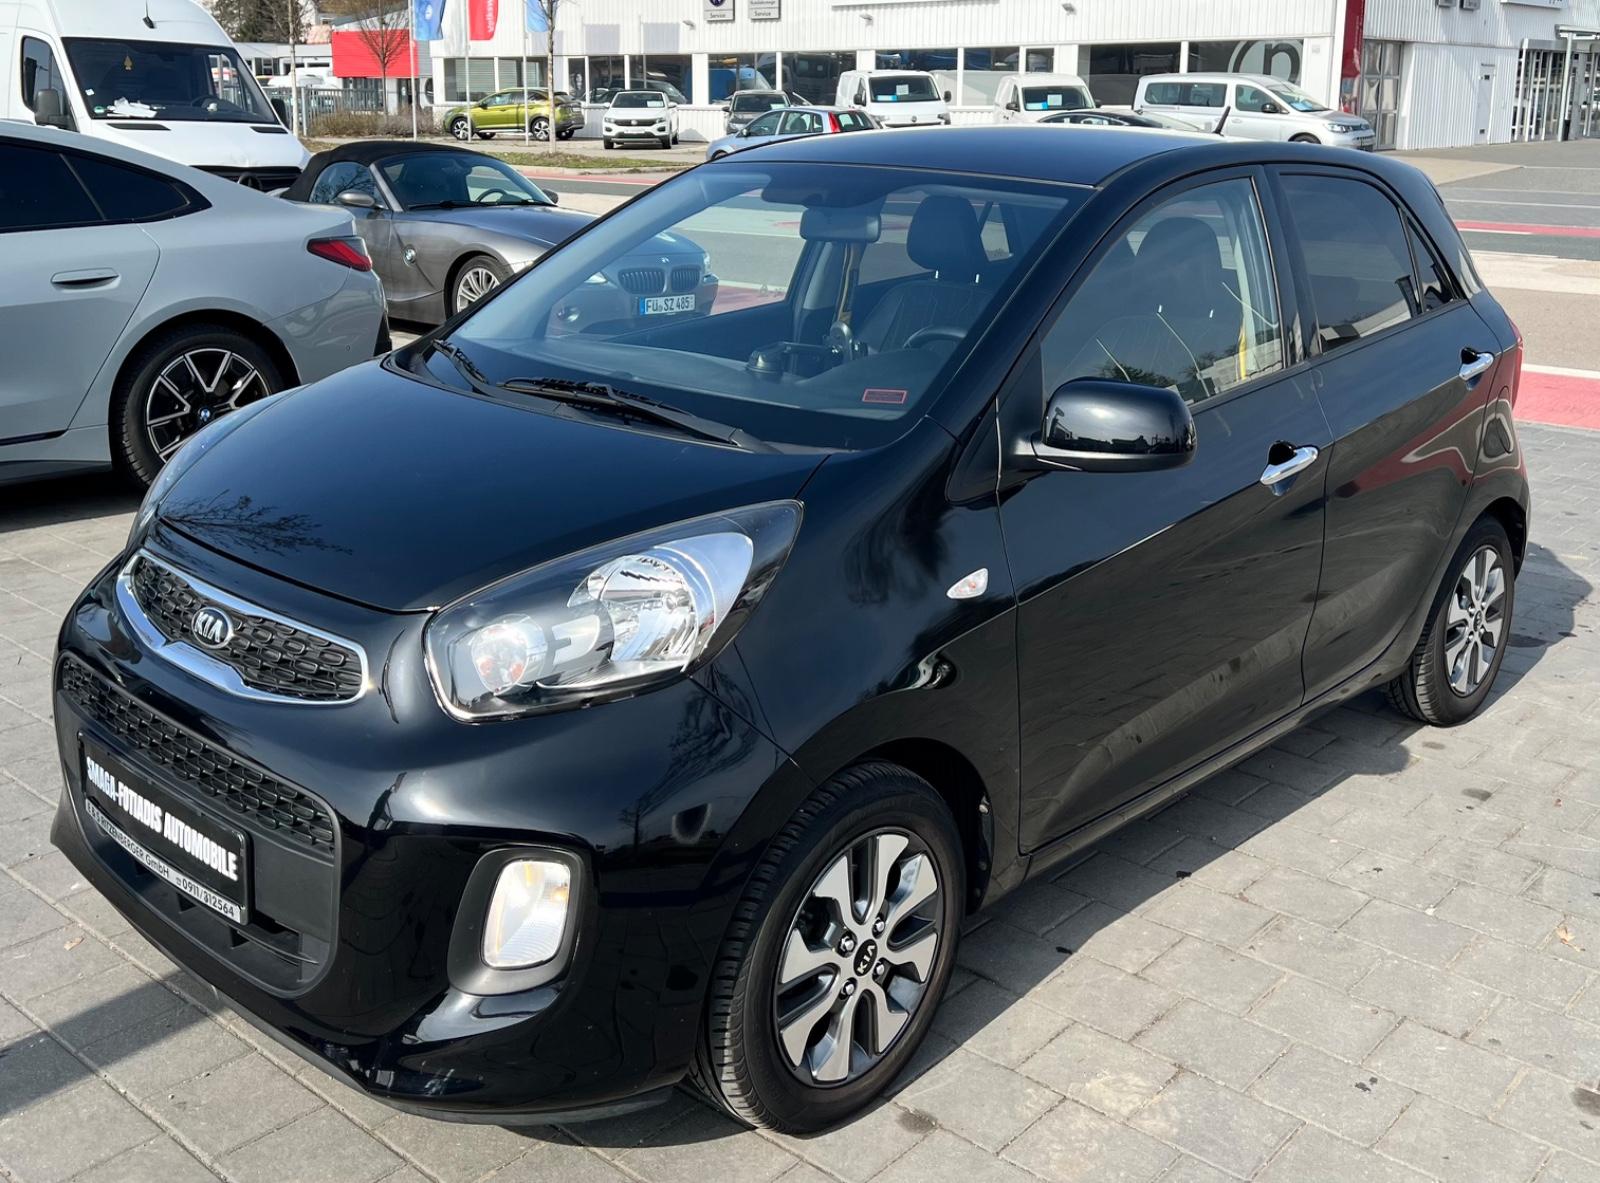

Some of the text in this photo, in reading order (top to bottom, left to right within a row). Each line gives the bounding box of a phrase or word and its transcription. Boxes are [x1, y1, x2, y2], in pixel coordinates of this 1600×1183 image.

[663, 297, 675, 312] SZ
[676, 296, 690, 310] 485
[194, 611, 223, 643] KIA
[163, 811, 238, 882] AUTOMOBILE
[145, 854, 169, 878] GmbH
[182, 878, 234, 917] 0911/312564
[856, 945, 876, 974] KIA
